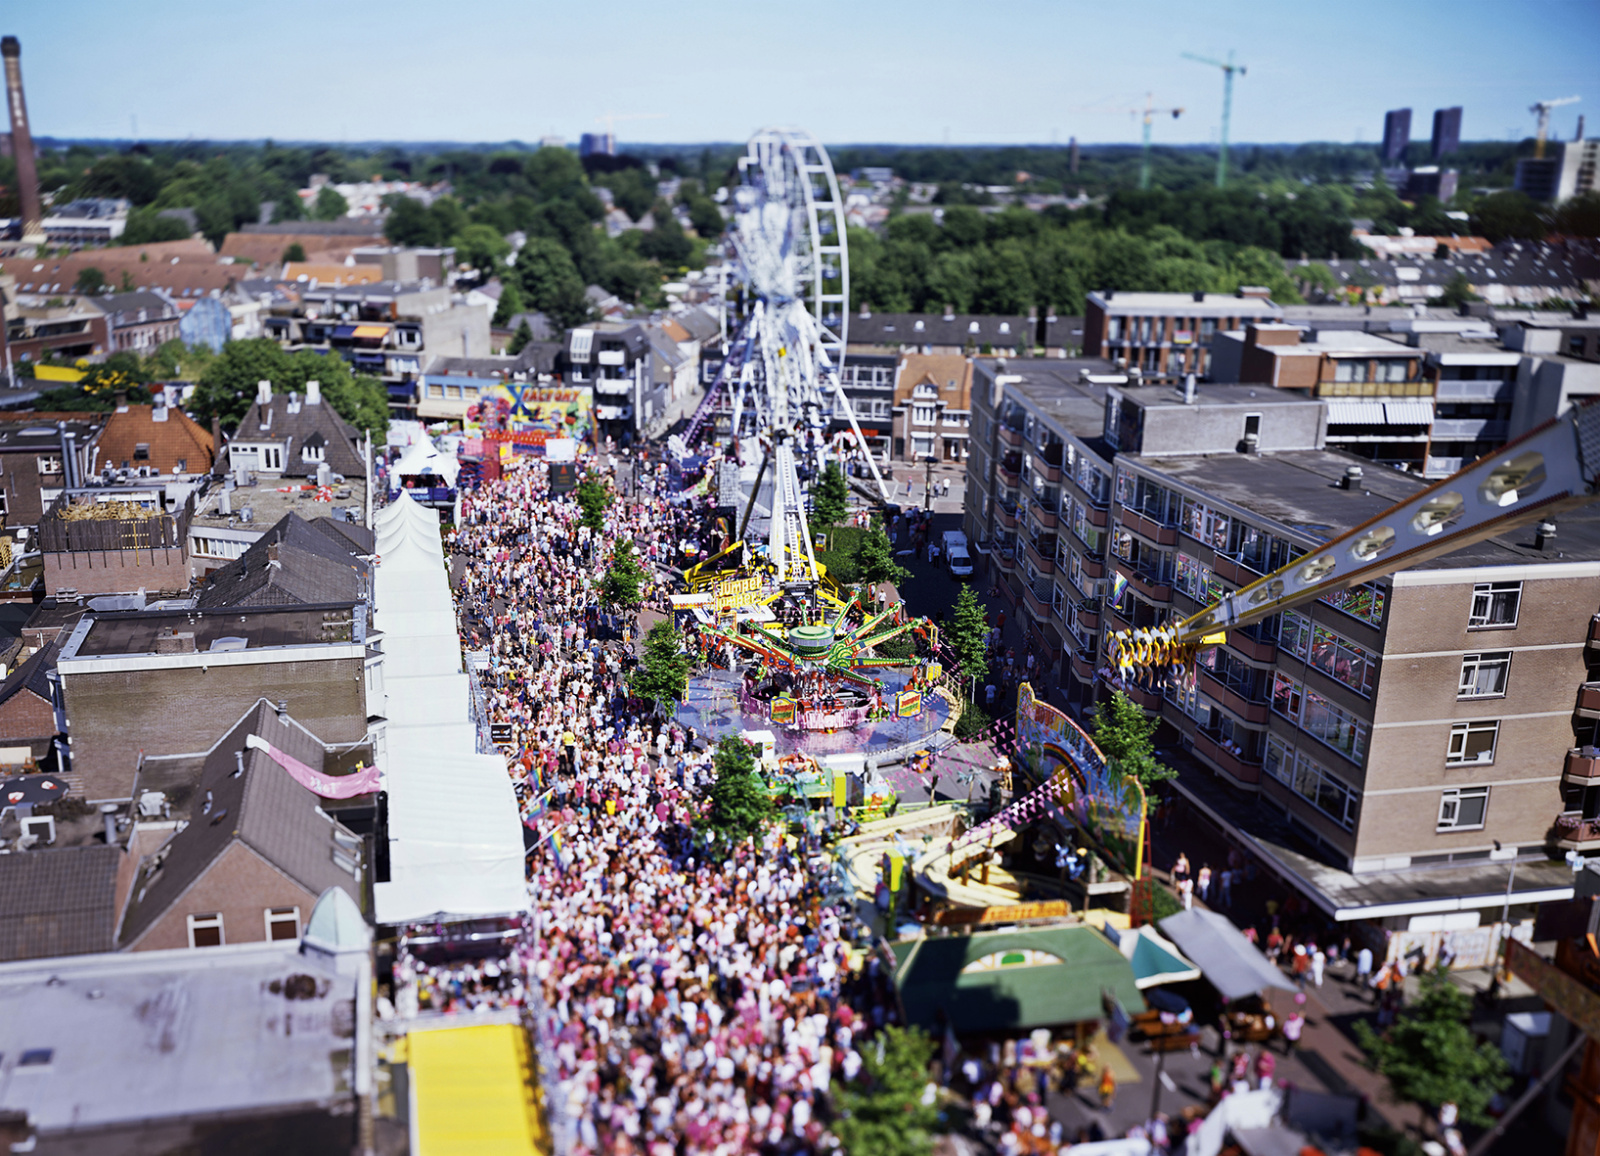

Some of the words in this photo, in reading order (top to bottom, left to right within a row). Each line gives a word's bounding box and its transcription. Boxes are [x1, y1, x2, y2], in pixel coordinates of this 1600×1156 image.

[506, 384, 531, 416] X
[522, 388, 581, 402] FACTORY
[718, 577, 762, 597] Jumper
